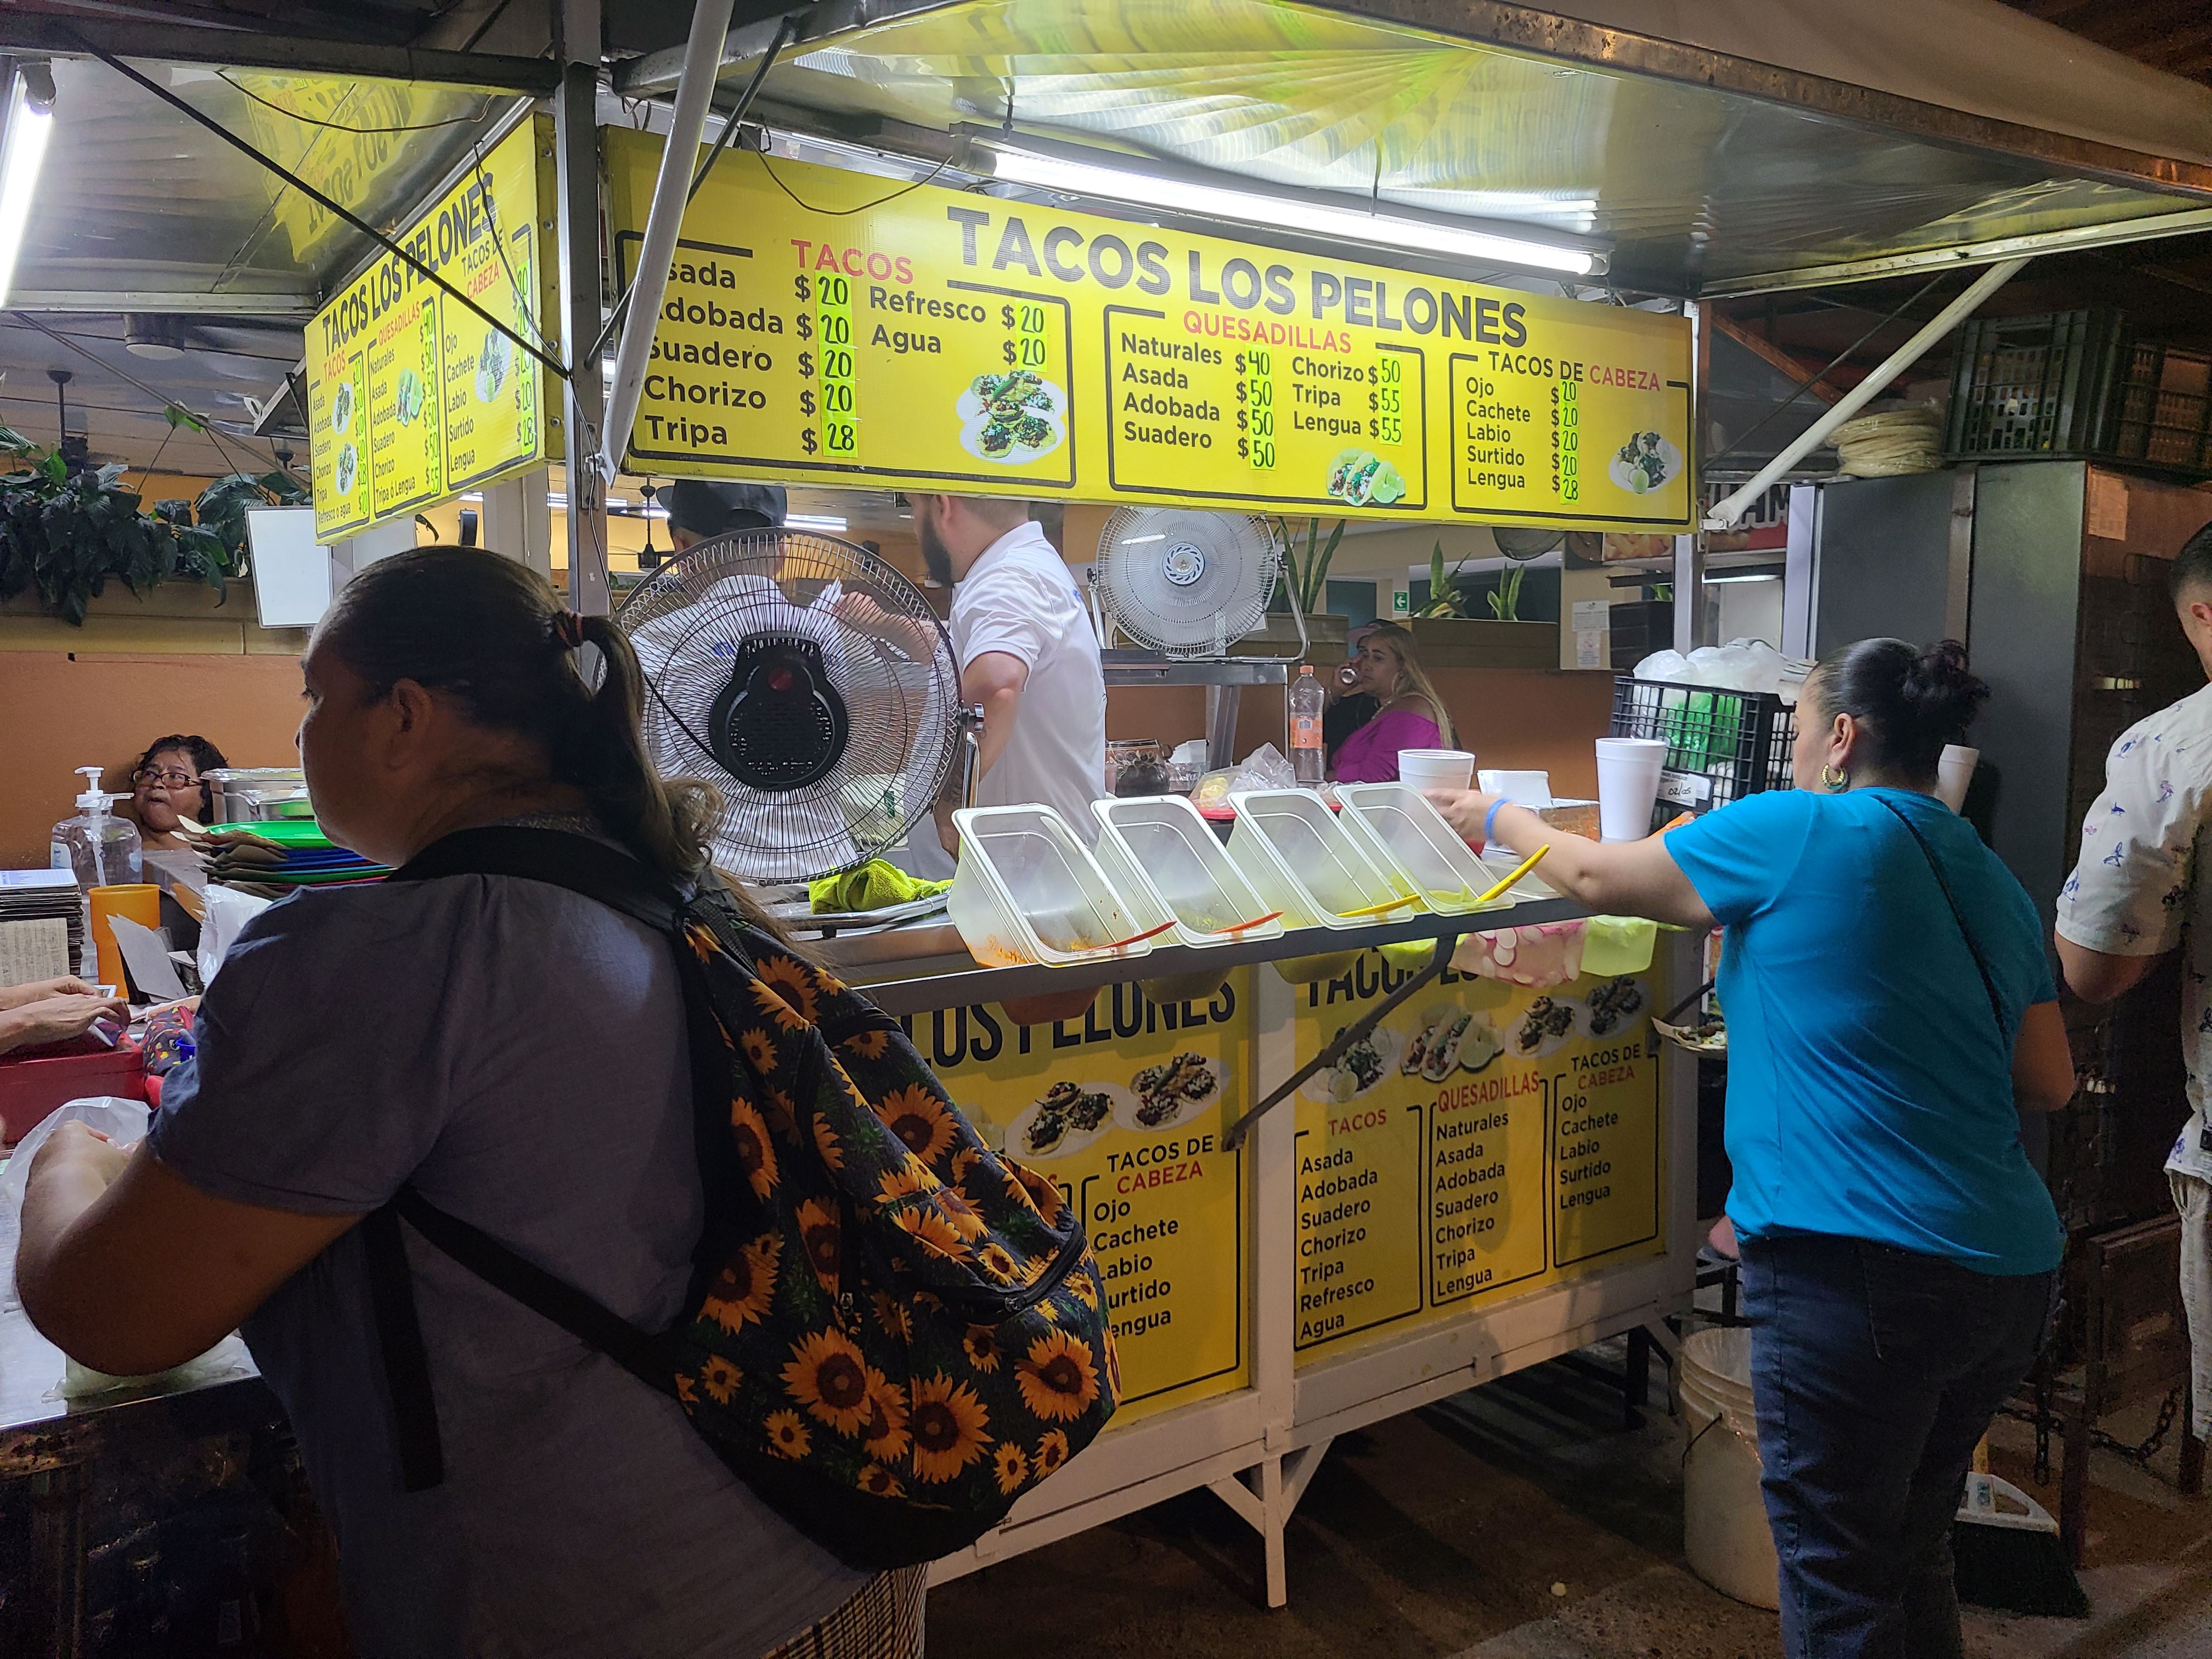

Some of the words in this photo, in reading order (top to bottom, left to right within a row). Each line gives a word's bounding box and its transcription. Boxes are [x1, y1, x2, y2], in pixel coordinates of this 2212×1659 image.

[323, 284, 368, 357] TACOS
[371, 255, 402, 321] LOS
[405, 172, 497, 293] PELONES
[462, 240, 490, 277] TACOS
[791, 239, 913, 284] TACOS
[467, 261, 500, 300] CABEZA
[668, 262, 736, 289] sada
[947, 206, 1170, 296] TACOS
[1188, 250, 1296, 315] LOS
[1312, 270, 1527, 348] PELONES
[659, 297, 783, 334] dobada
[870, 285, 986, 324] Refresco
[379, 301, 420, 346] QUESADILLAS
[1183, 310, 1351, 353] QUESADILLAS
[445, 334, 458, 356] Ojo
[650, 336, 772, 371] Suadero
[871, 324, 942, 356] Agua
[1121, 332, 1222, 365] Naturales
[324, 350, 346, 383] TACOS
[370, 348, 395, 377] Naturales
[447, 355, 475, 383] Cachete
[1122, 362, 1188, 390] Asada
[1292, 356, 1364, 382] Chorizo
[1488, 351, 1554, 377] TACOS
[1560, 360, 1583, 382] DE
[1589, 365, 1660, 392] CABEZA
[372, 379, 388, 402] Asada
[644, 375, 766, 409] Chorizo
[1293, 383, 1341, 408] Tripa
[1466, 376, 1494, 399] Ojo
[313, 394, 325, 411] Asada
[373, 402, 397, 428] Adobada
[448, 391, 467, 413] Labio
[1123, 391, 1220, 421] Adobada
[1467, 400, 1531, 422] Cachete
[314, 413, 332, 435] Adobada
[449, 417, 474, 443] Surtido
[645, 415, 727, 447] Tripa
[1124, 421, 1212, 449] Suadero
[1294, 411, 1361, 437] Lengua
[1467, 422, 1511, 443] Labio
[315, 439, 332, 458] Suadero
[374, 431, 396, 453] Suadero
[1468, 445, 1525, 467] Surtido
[317, 462, 332, 481] Chorizo
[375, 459, 395, 479] Chorizo
[450, 448, 476, 473] Lengua
[376, 486, 389, 506] Tripa
[395, 477, 416, 500] Lengua
[1468, 467, 1525, 490] Lengua
[317, 488, 328, 504] Tripa
[318, 507, 335, 525] Refresco
[340, 501, 352, 519] agua
[1571, 1051, 1619, 1071] TACOS
[1622, 1043, 1641, 1062] DE
[1438, 1070, 1539, 1113] QUESADILLAS
[1577, 1064, 1635, 1091] CABEZA
[1562, 1094, 1587, 1114] Ojo
[1329, 1108, 1387, 1138] TACOS
[1436, 1111, 1509, 1141] Naturales
[1561, 1110, 1618, 1137] Cachete
[1107, 1142, 1179, 1172] TACOS
[1187, 1135, 1214, 1157] DE
[1301, 1148, 1353, 1175] Asada
[1436, 1142, 1483, 1166] Asada
[1560, 1138, 1600, 1160] Labio
[1116, 1160, 1203, 1194] CABEZA
[1301, 1169, 1378, 1202] Adobada
[1435, 1161, 1505, 1193] Adobada
[1560, 1160, 1611, 1186] Surtido
[1435, 1189, 1499, 1218] Suadero
[1560, 1184, 1611, 1209] Lengua
[1093, 1199, 1131, 1223] Ojo
[1301, 1199, 1370, 1230] Suadero
[1094, 1219, 1179, 1251] Cachete
[1301, 1225, 1367, 1257] Chorizo
[1436, 1215, 1495, 1244] Chorizo
[1300, 1259, 1344, 1284] Tripa
[1436, 1246, 1475, 1271] Tripa
[1109, 1279, 1171, 1309] urtido
[1300, 1277, 1375, 1312] Refresco
[1436, 1267, 1493, 1297] Lengua
[1112, 1310, 1171, 1340] engua
[1299, 1313, 1345, 1340] Agua
